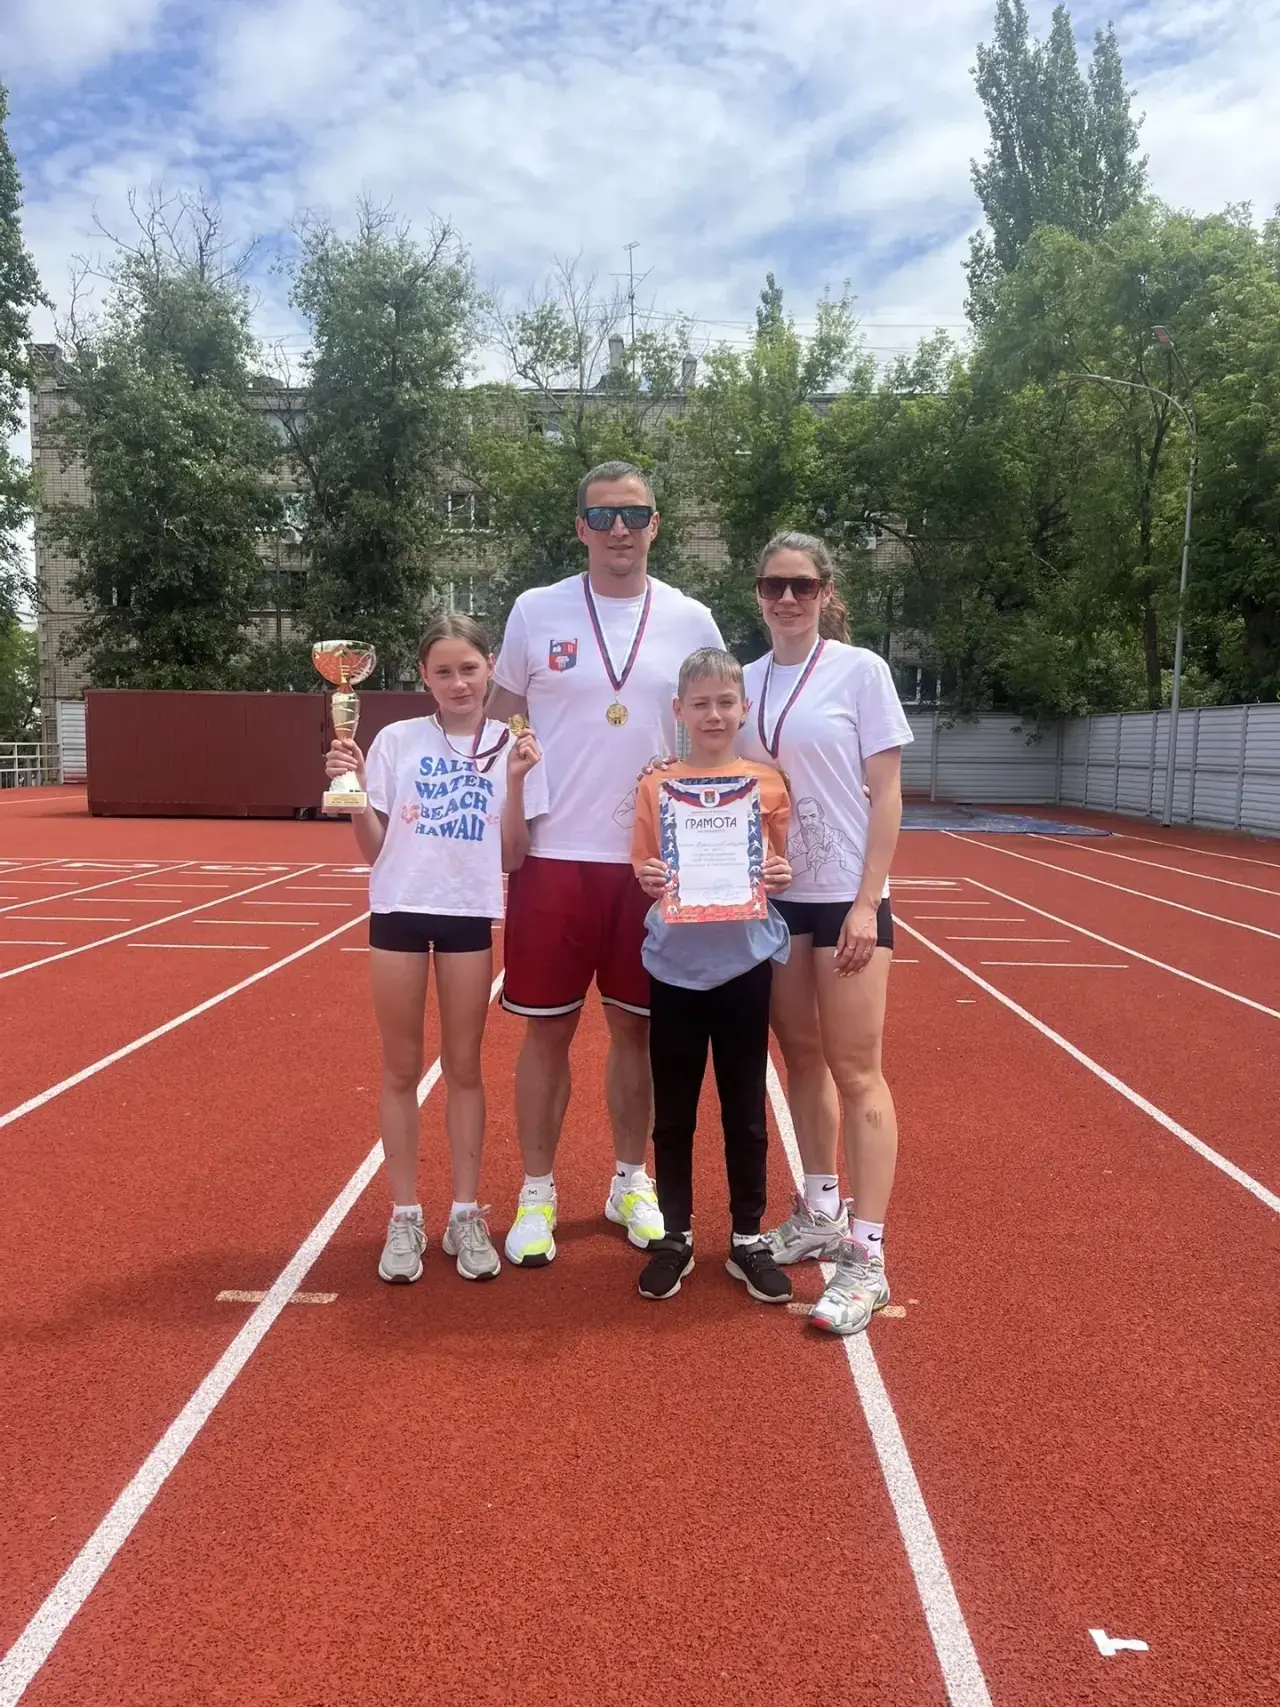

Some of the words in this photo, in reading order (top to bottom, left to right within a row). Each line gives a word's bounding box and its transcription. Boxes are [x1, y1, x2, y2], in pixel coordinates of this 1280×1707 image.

[419, 756, 474, 777] SALT
[415, 775, 494, 800] WATER
[420, 791, 488, 820] BEACH
[415, 814, 485, 841] HAWAII
[685, 816, 737, 830] ГРАМОТА
